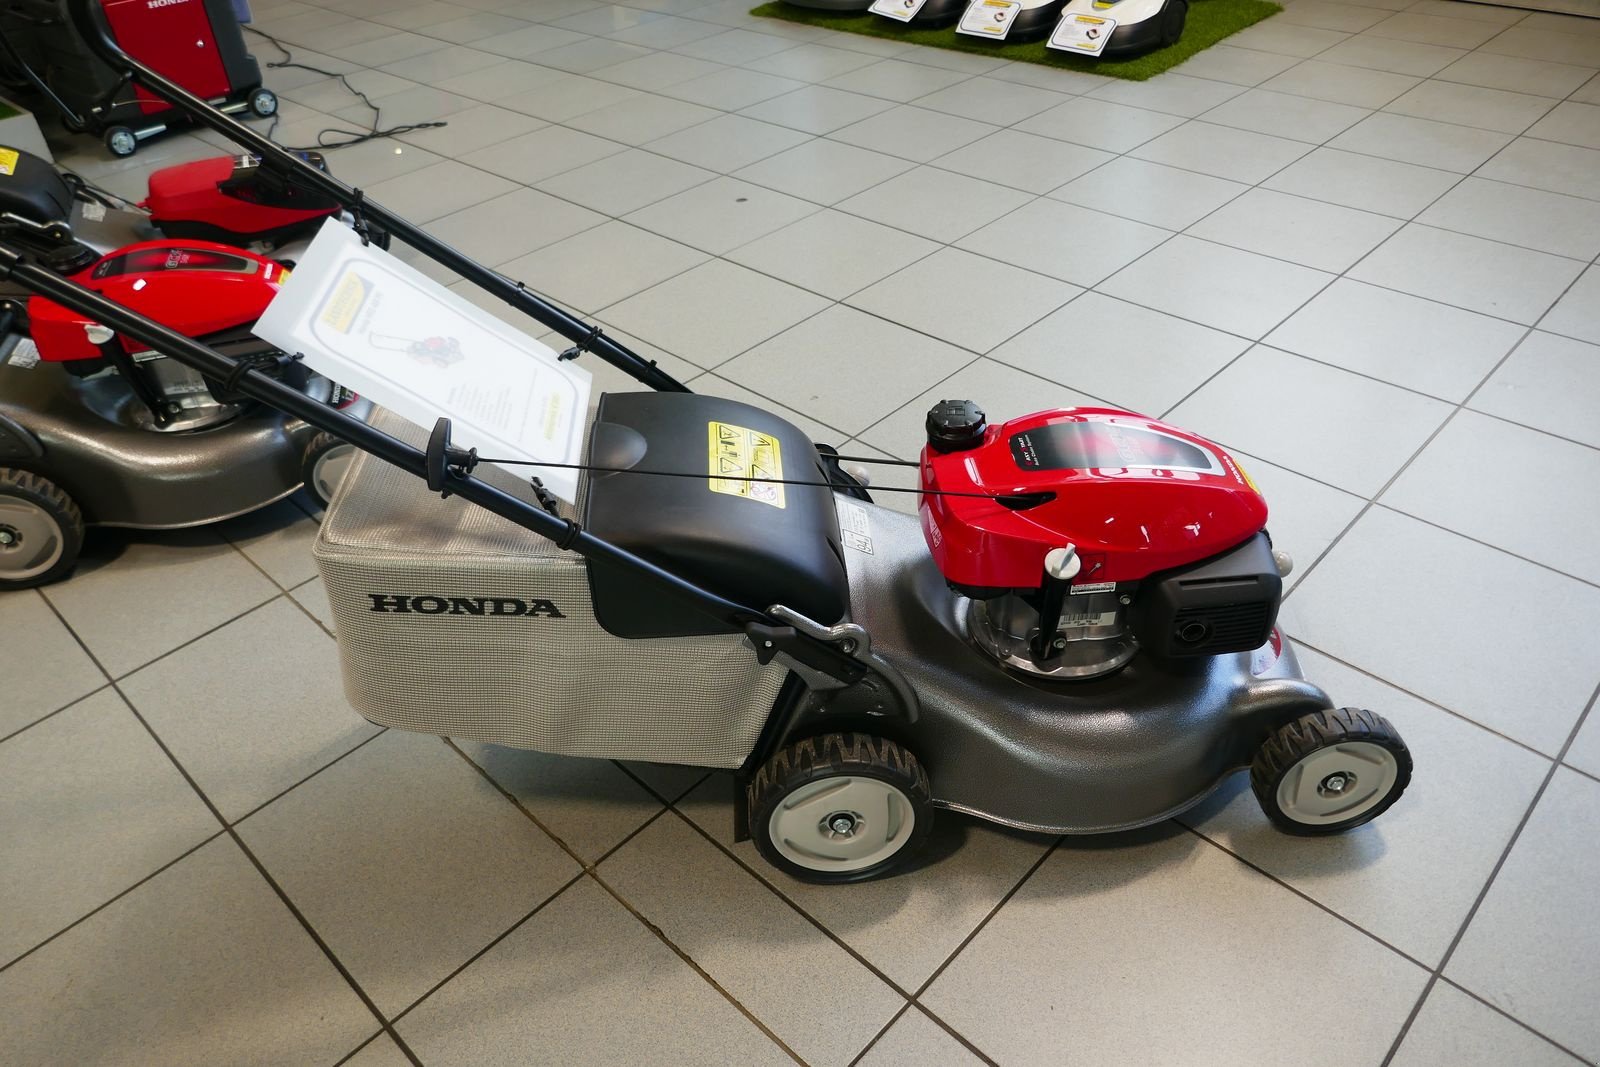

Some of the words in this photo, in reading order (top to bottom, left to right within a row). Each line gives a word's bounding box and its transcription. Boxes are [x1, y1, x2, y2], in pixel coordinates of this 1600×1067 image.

[147, 0, 190, 9] HON
[332, 382, 342, 403] HOND
[1222, 455, 1244, 485] HONDA
[367, 594, 567, 619] HONDA
